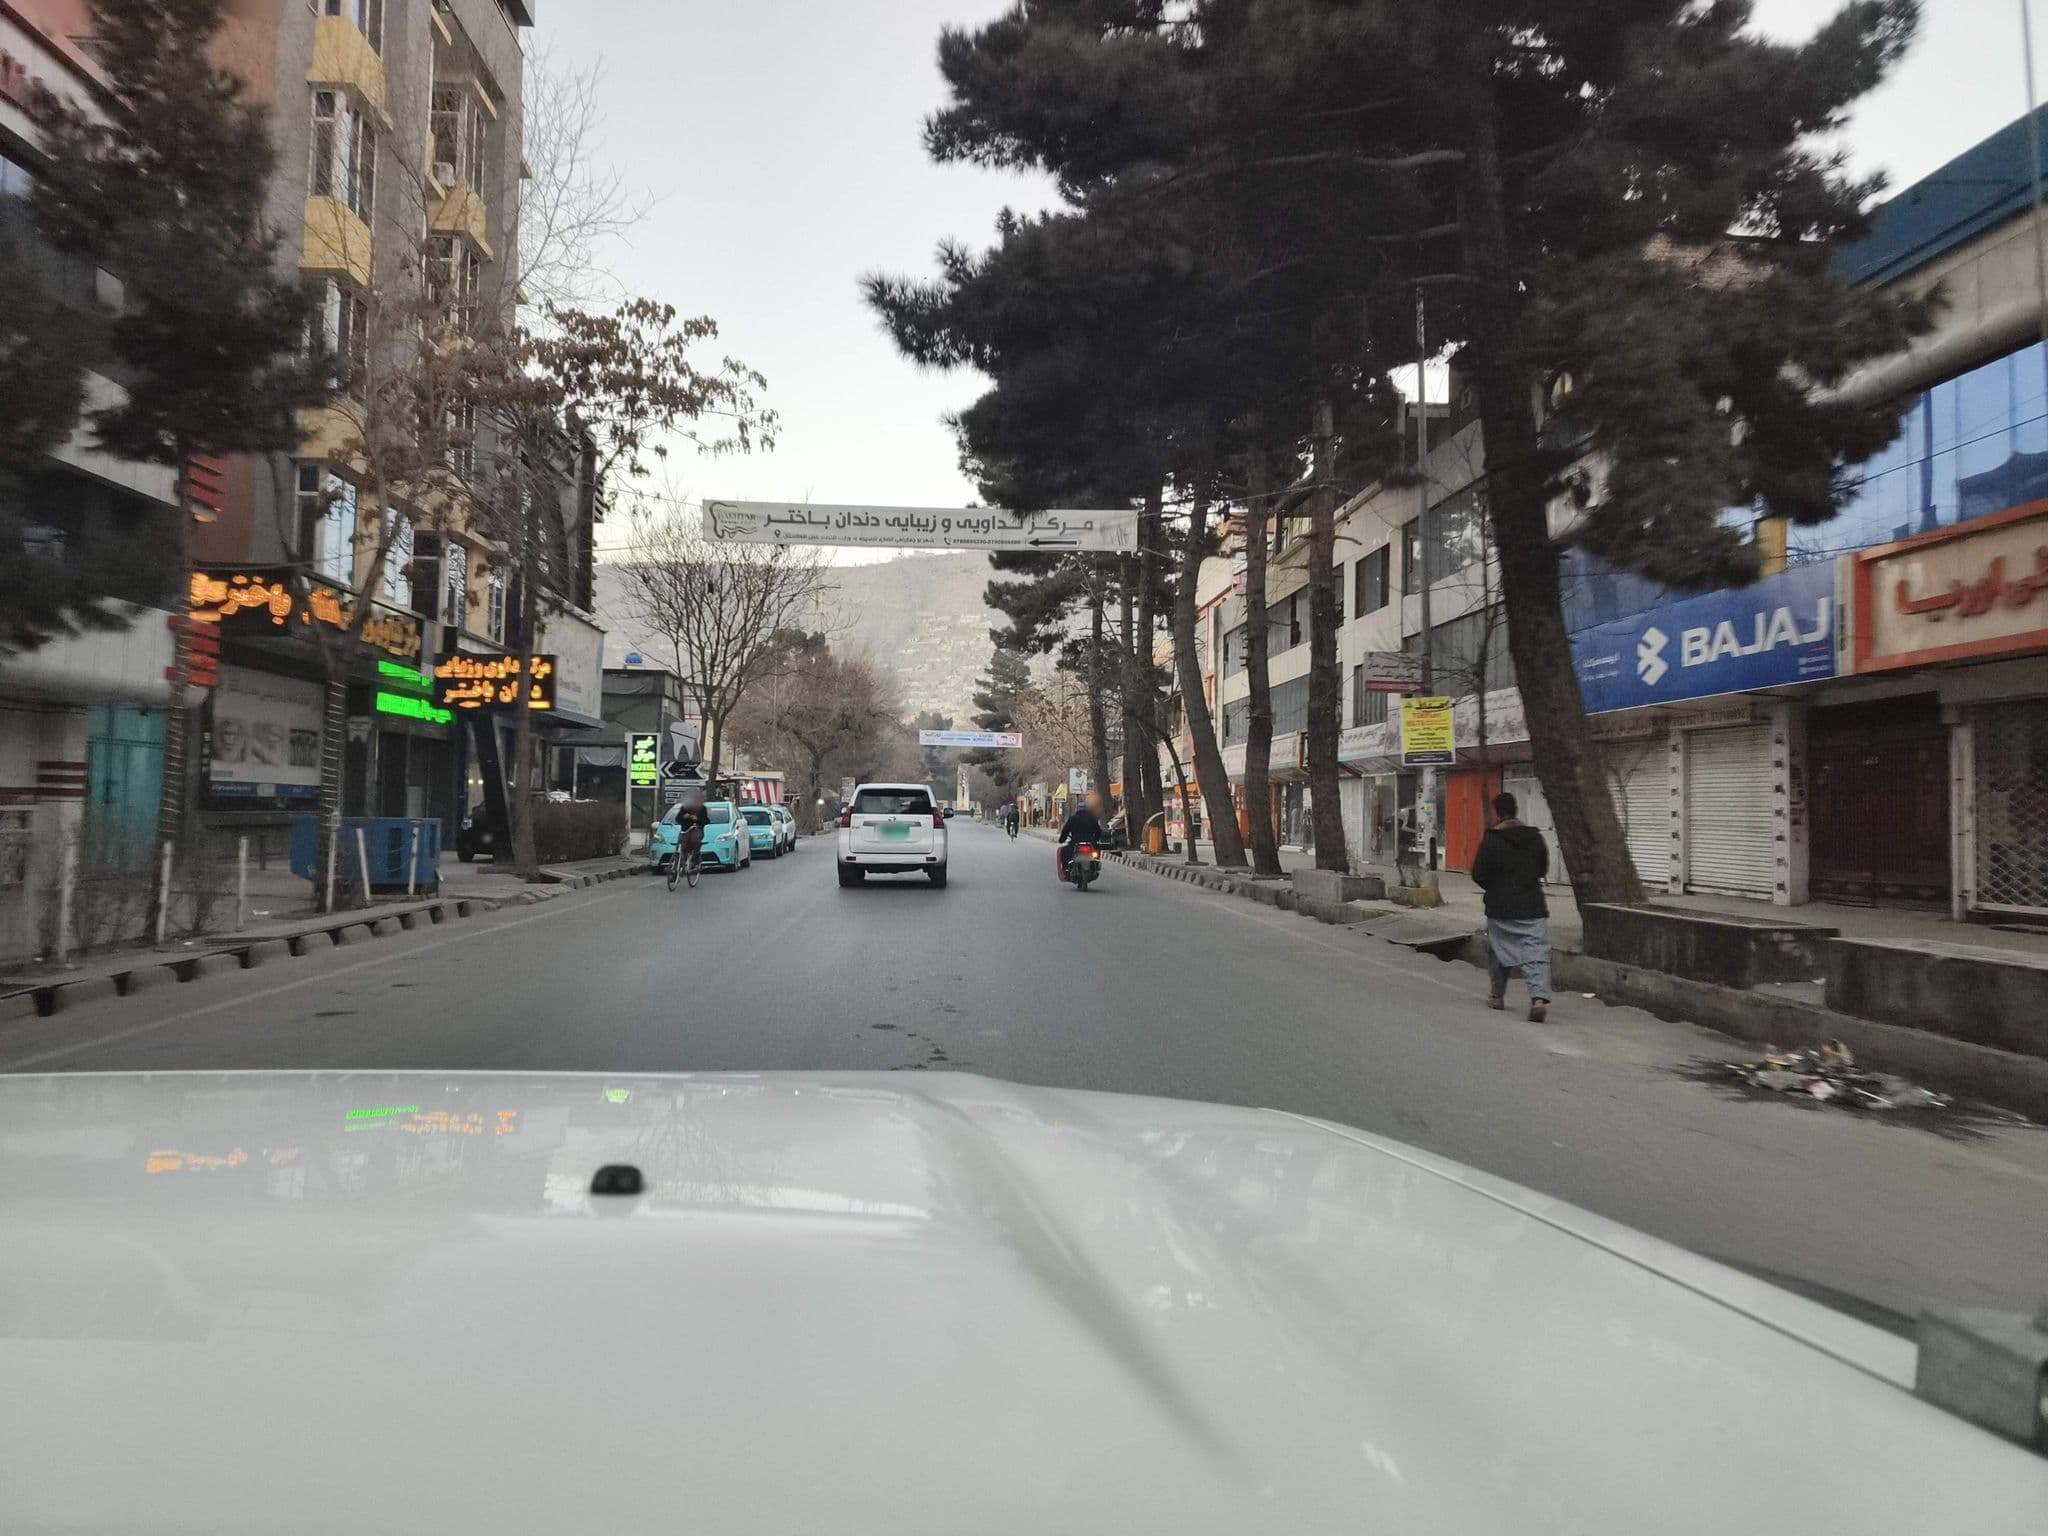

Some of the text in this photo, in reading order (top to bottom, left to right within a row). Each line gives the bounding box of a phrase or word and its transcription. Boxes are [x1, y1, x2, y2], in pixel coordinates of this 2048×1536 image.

[763, 509, 830, 528] باختر
[835, 511, 881, 529] دندان
[885, 513, 937, 533] زیبایی
[941, 517, 951, 533] و
[1681, 596, 1833, 668] BAJAJ
[443, 680, 495, 703] باختر
